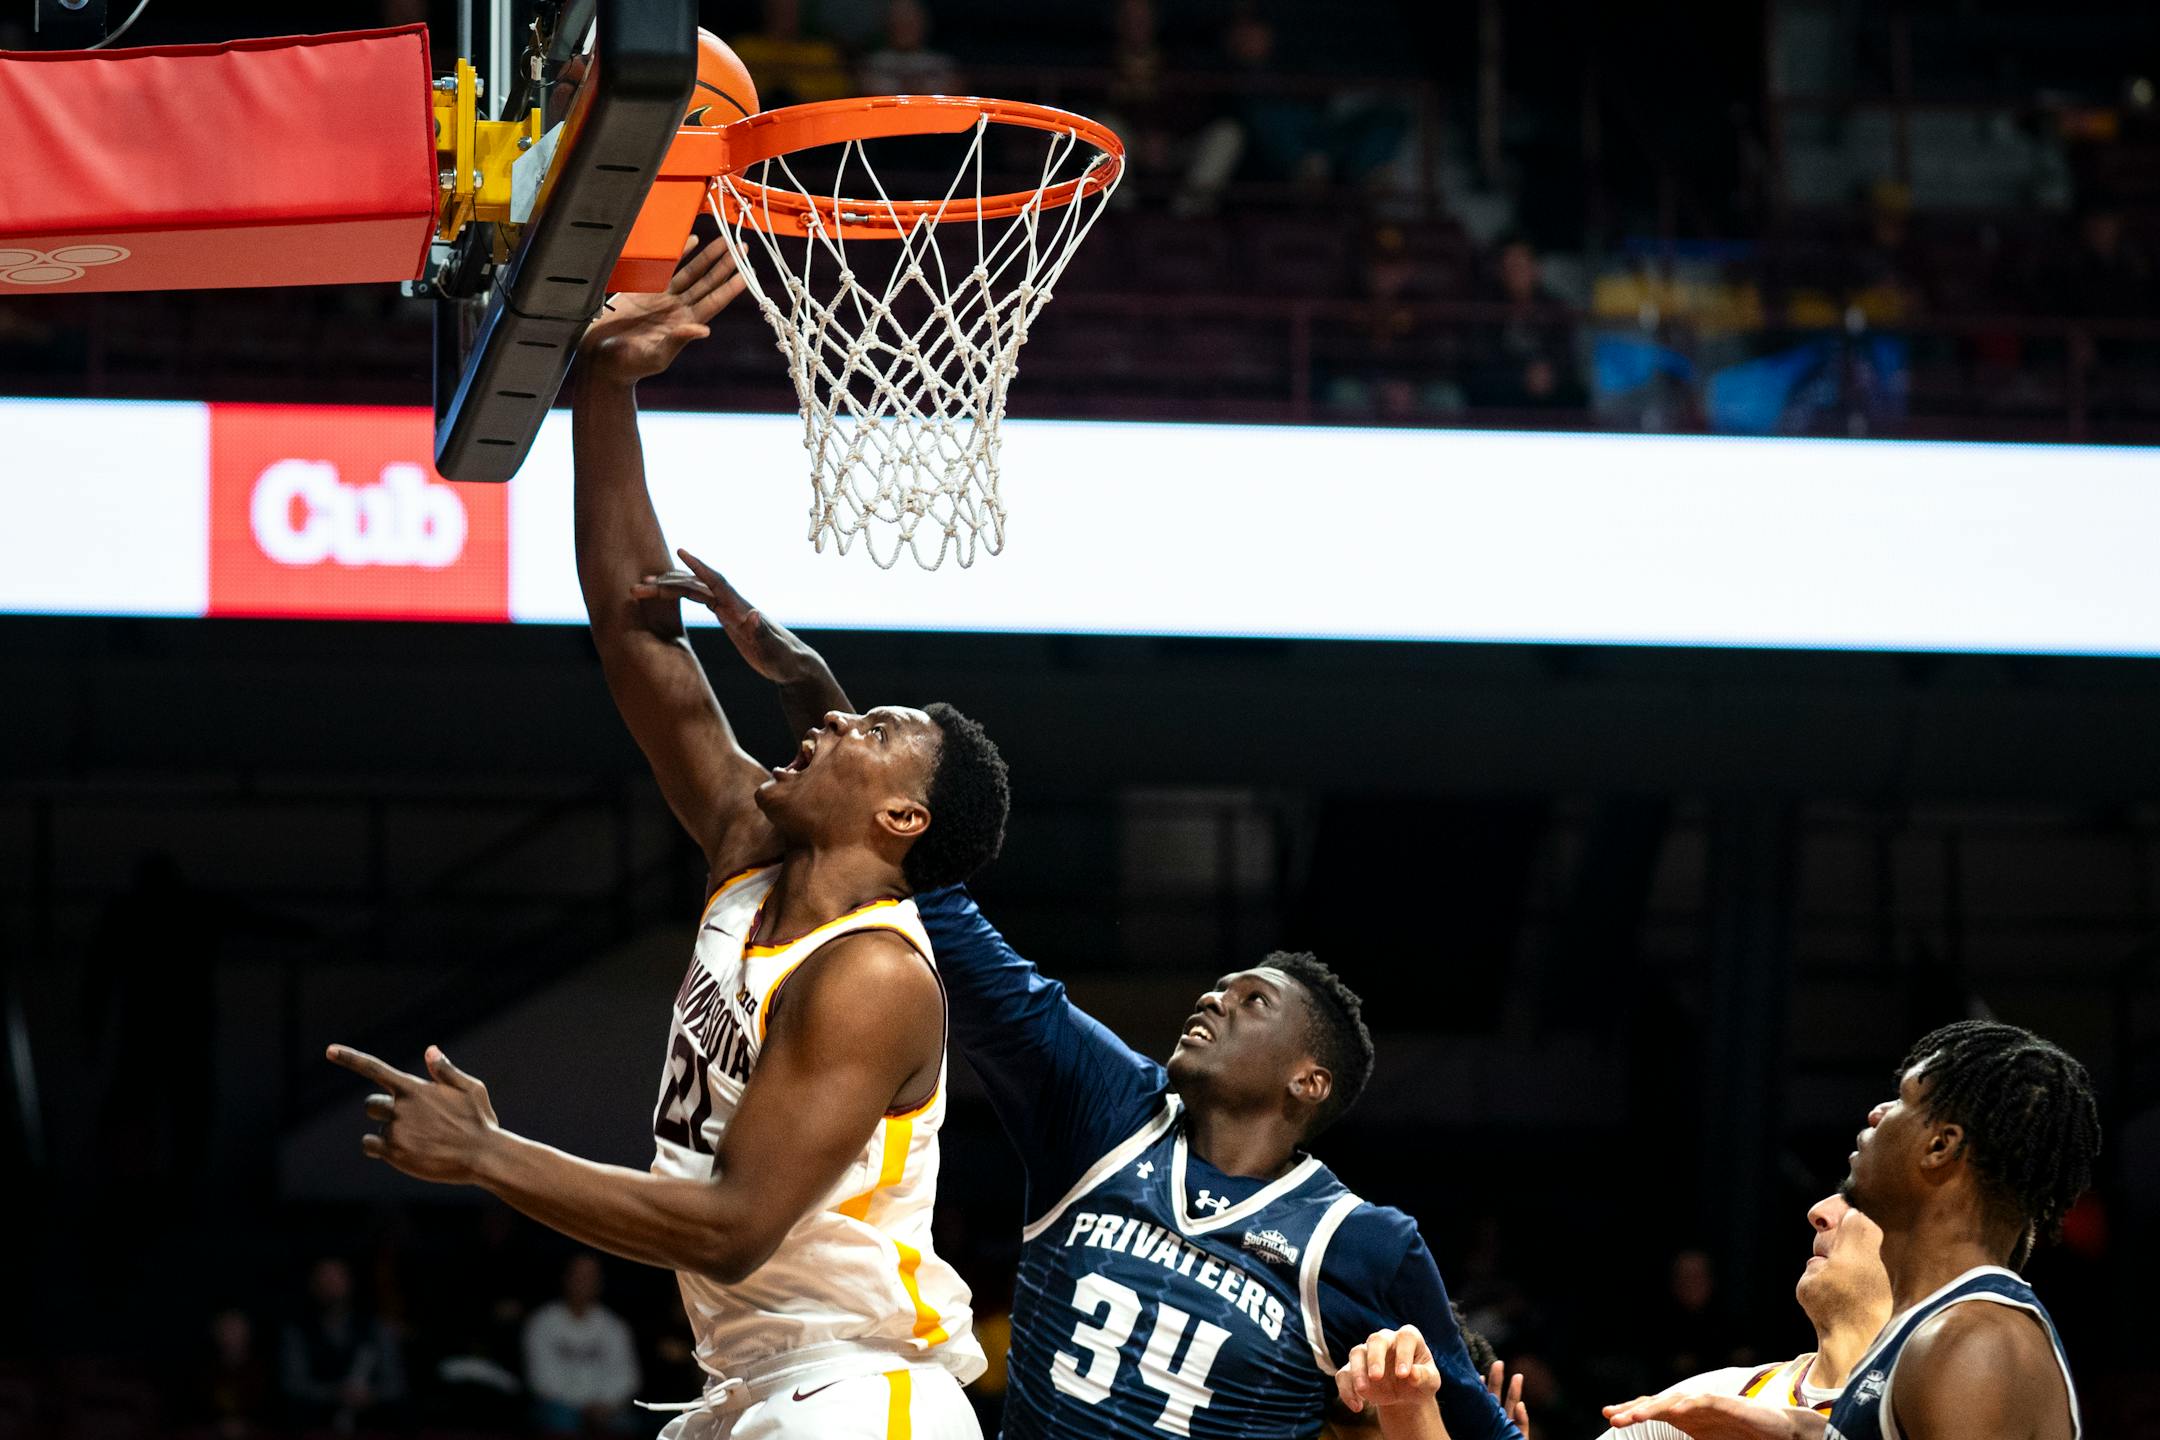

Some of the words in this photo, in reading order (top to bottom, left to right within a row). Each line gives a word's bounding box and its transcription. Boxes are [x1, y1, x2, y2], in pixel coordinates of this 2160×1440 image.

[250, 459, 469, 570] Cub
[675, 951, 751, 1084] INNESOTA
[655, 1032, 715, 1155] 21
[1064, 1213, 1285, 1341] PRIVATEERS
[1243, 1231, 1300, 1265] SOUTHLAND
[1050, 1272, 1233, 1437] 34
